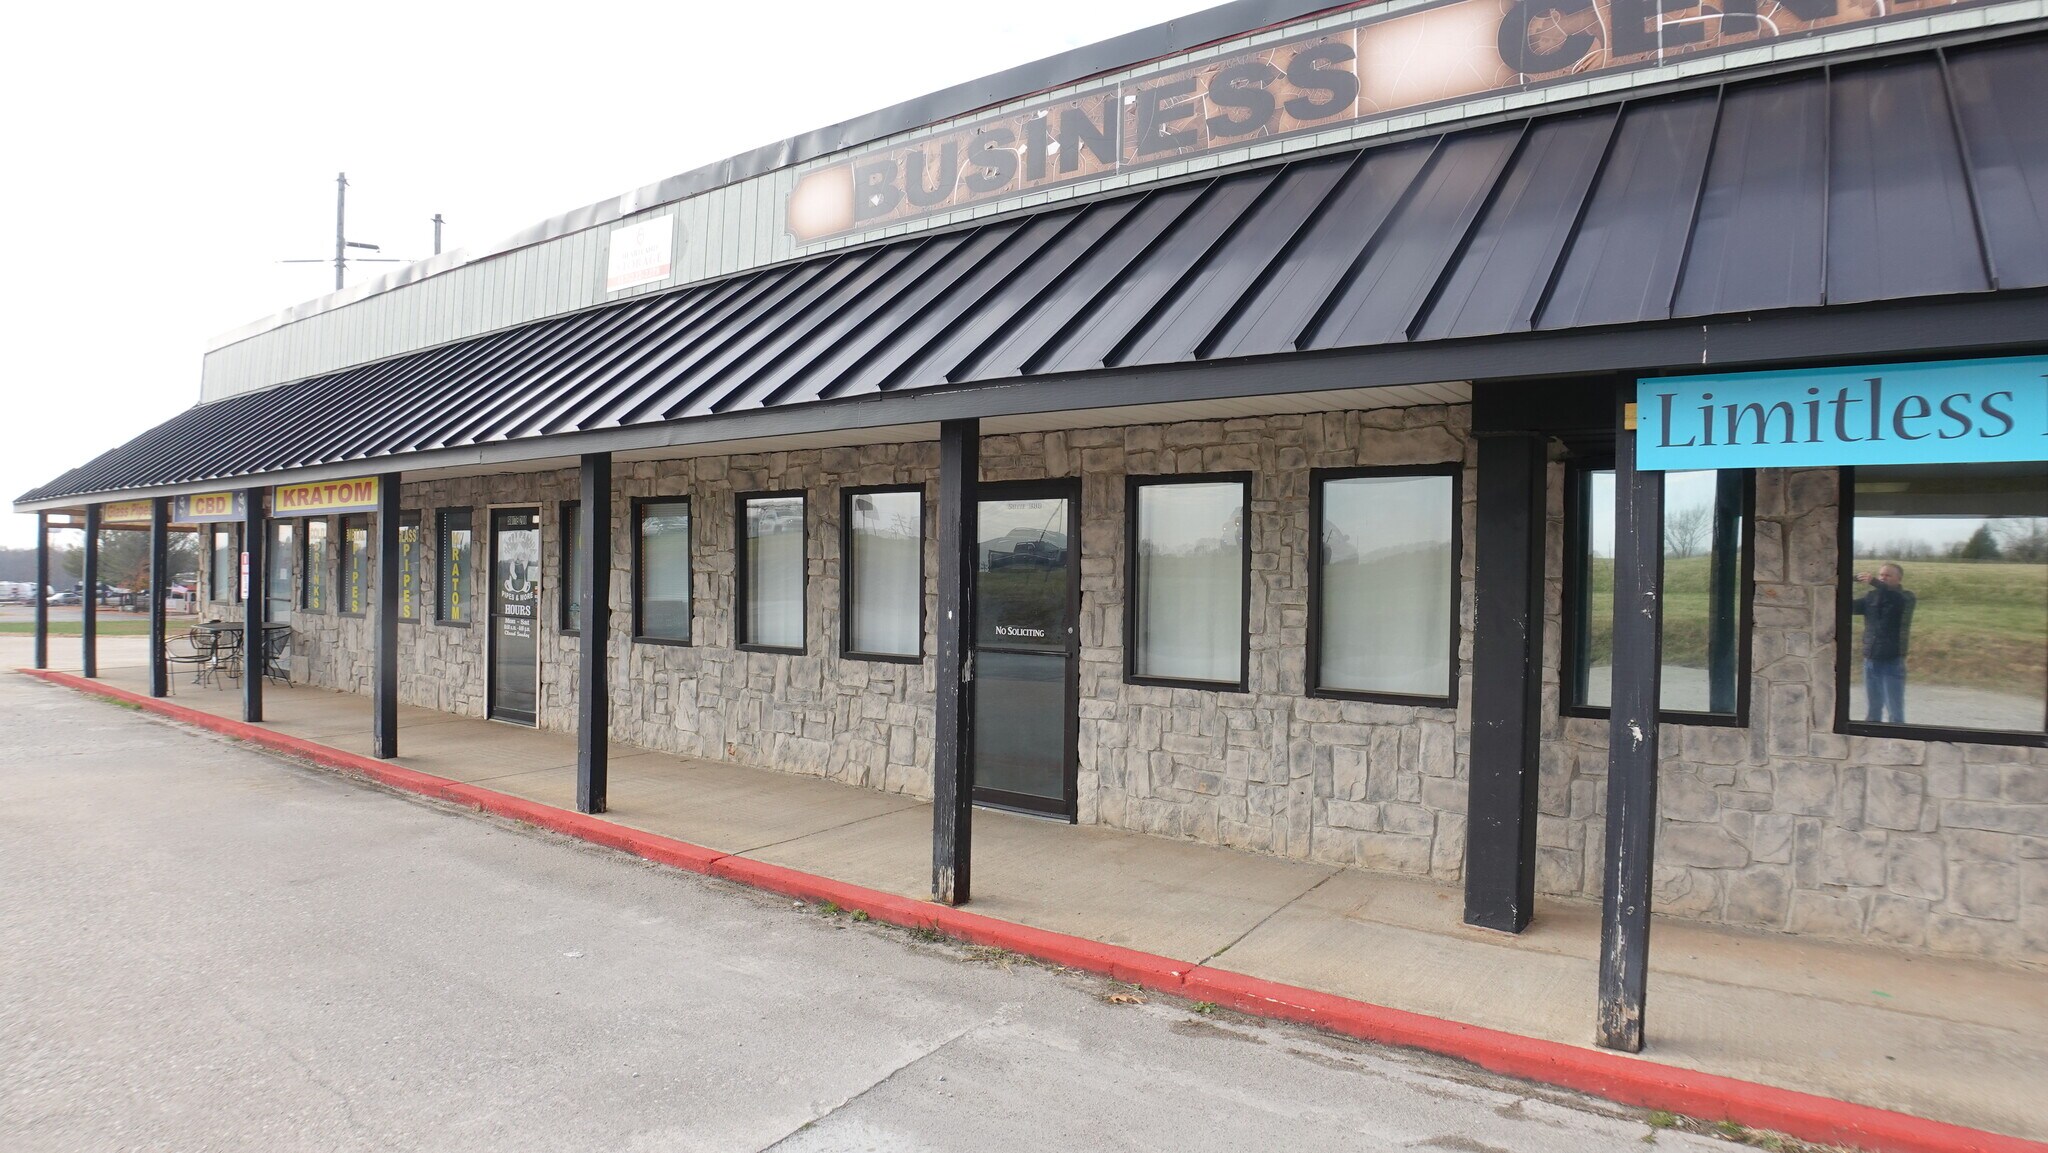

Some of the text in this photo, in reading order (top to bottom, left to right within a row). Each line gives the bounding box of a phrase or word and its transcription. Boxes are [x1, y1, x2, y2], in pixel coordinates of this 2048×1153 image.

[854, 42, 1359, 222] BUSINESS
[1655, 377, 2014, 448] Limitless
[107, 504, 129, 518] Glass
[194, 496, 226, 515] CBD
[282, 480, 373, 508] KRATOM
[313, 542, 321, 609] DRINKS
[351, 543, 359, 613] PIPES
[403, 543, 411, 618] PIPES
[451, 531, 461, 620] KRATOM
[501, 590, 515, 601] PIPES
[504, 604, 531, 616] HOURS
[1007, 626, 1045, 637] SOLICITING
